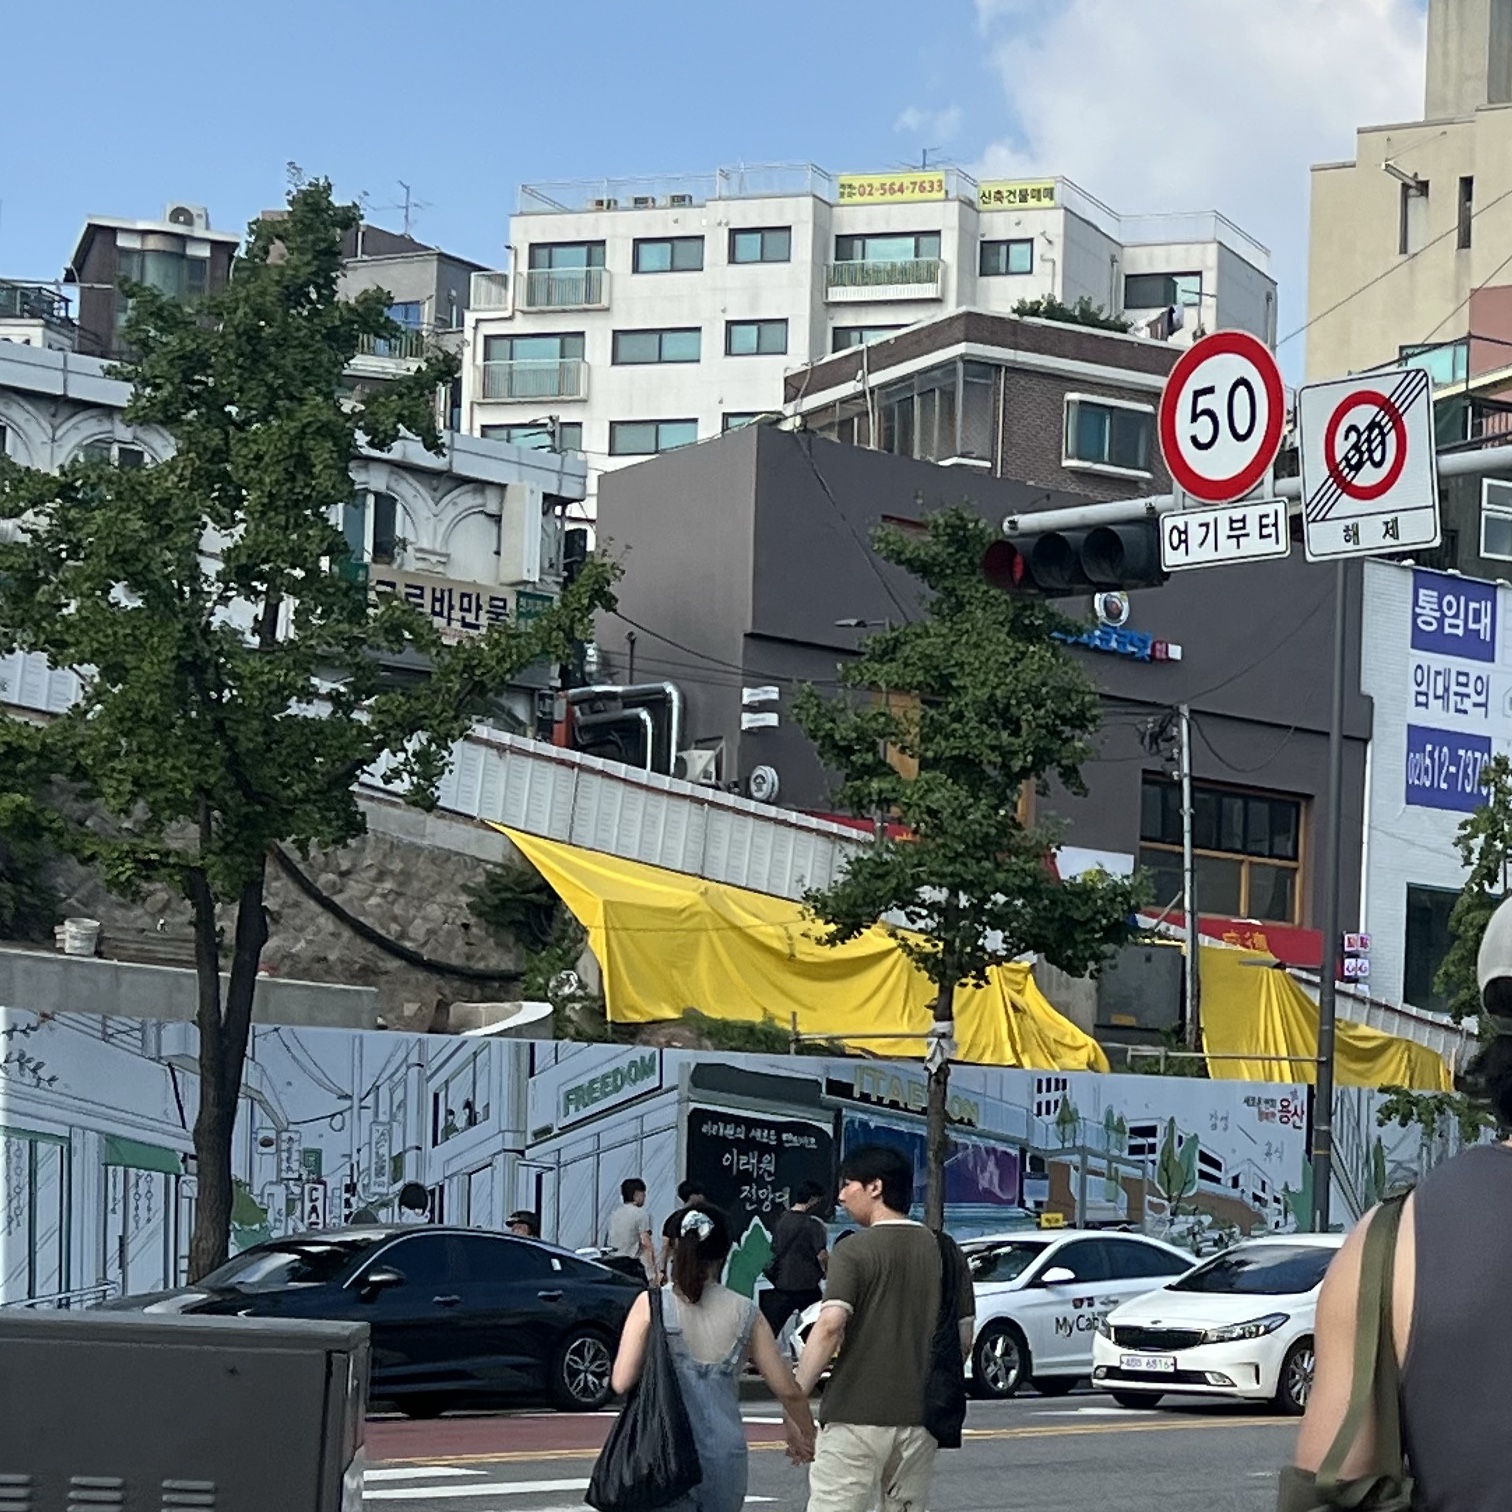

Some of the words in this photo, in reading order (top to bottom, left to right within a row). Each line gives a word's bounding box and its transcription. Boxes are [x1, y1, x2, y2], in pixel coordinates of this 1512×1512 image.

[1190, 376, 1257, 451] 50
[1169, 508, 1280, 557] 여기부터
[1415, 588, 1492, 642] 통임대
[1414, 664, 1491, 719] 임대문의
[563, 1051, 656, 1118] FREEDOM
[855, 1064, 979, 1125] ITAEON
[1278, 1097, 1305, 1130] 용산
